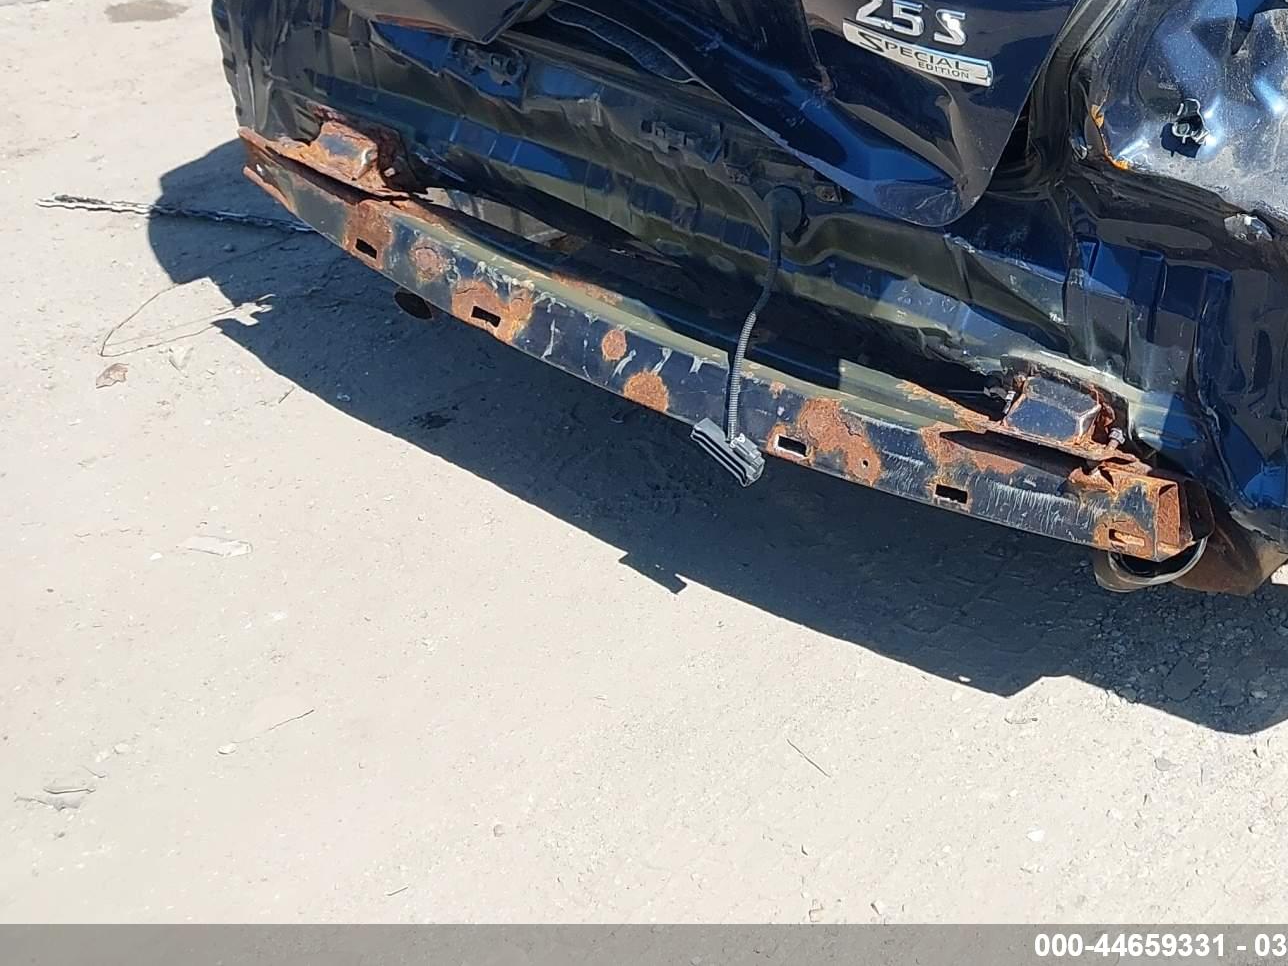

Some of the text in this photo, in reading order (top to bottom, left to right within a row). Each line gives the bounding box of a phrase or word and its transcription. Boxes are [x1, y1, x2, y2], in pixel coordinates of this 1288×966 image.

[933, 8, 967, 47] S
[857, 30, 971, 73] SPECIAL
[917, 61, 970, 80] EDITION
